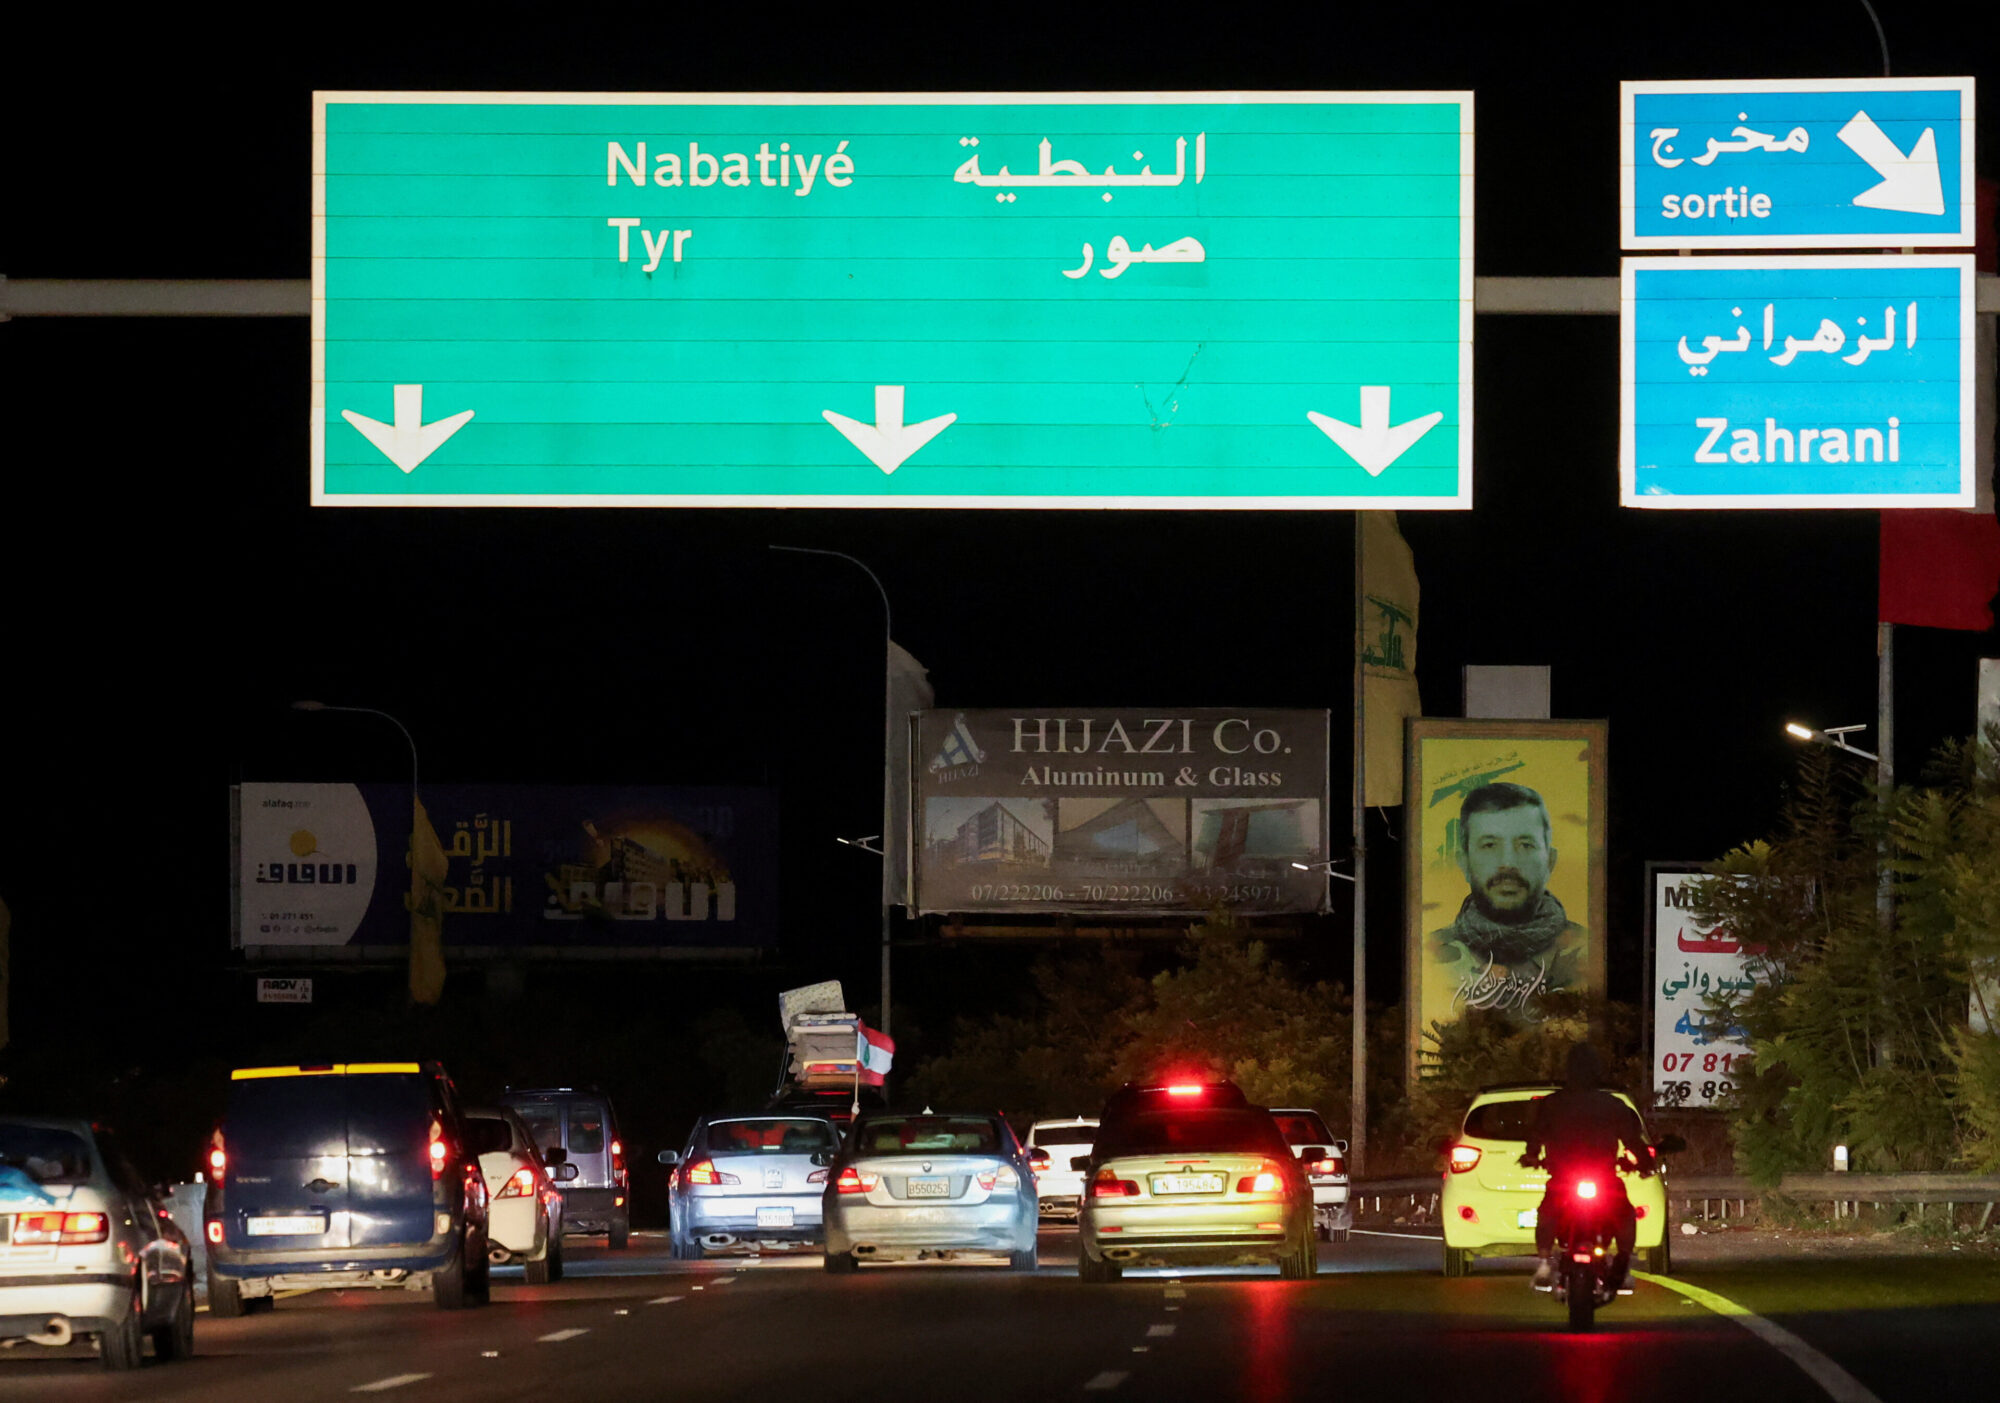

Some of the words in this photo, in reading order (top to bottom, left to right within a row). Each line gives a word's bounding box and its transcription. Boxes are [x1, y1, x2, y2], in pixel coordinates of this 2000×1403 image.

[1650, 112, 1810, 168] مخرج
[608, 141, 855, 197] Nabatiyé
[954, 131, 1206, 203] النبطية
[1661, 185, 1772, 219] sortie
[607, 218, 692, 273] Tyr
[1063, 235, 1206, 280] صور
[1677, 301, 1917, 377] الزهراني
[1694, 416, 1900, 464] Zahrani
[1009, 717, 1196, 754] HIJAZI
[1212, 718, 1293, 755] Co.
[1020, 766, 1166, 787] Aluminum
[1174, 766, 1199, 787] &
[1208, 766, 1283, 787] Glass
[971, 885, 1065, 901] 07/222206
[1081, 885, 1174, 901] 70/222206
[1663, 1053, 1695, 1072] 07
